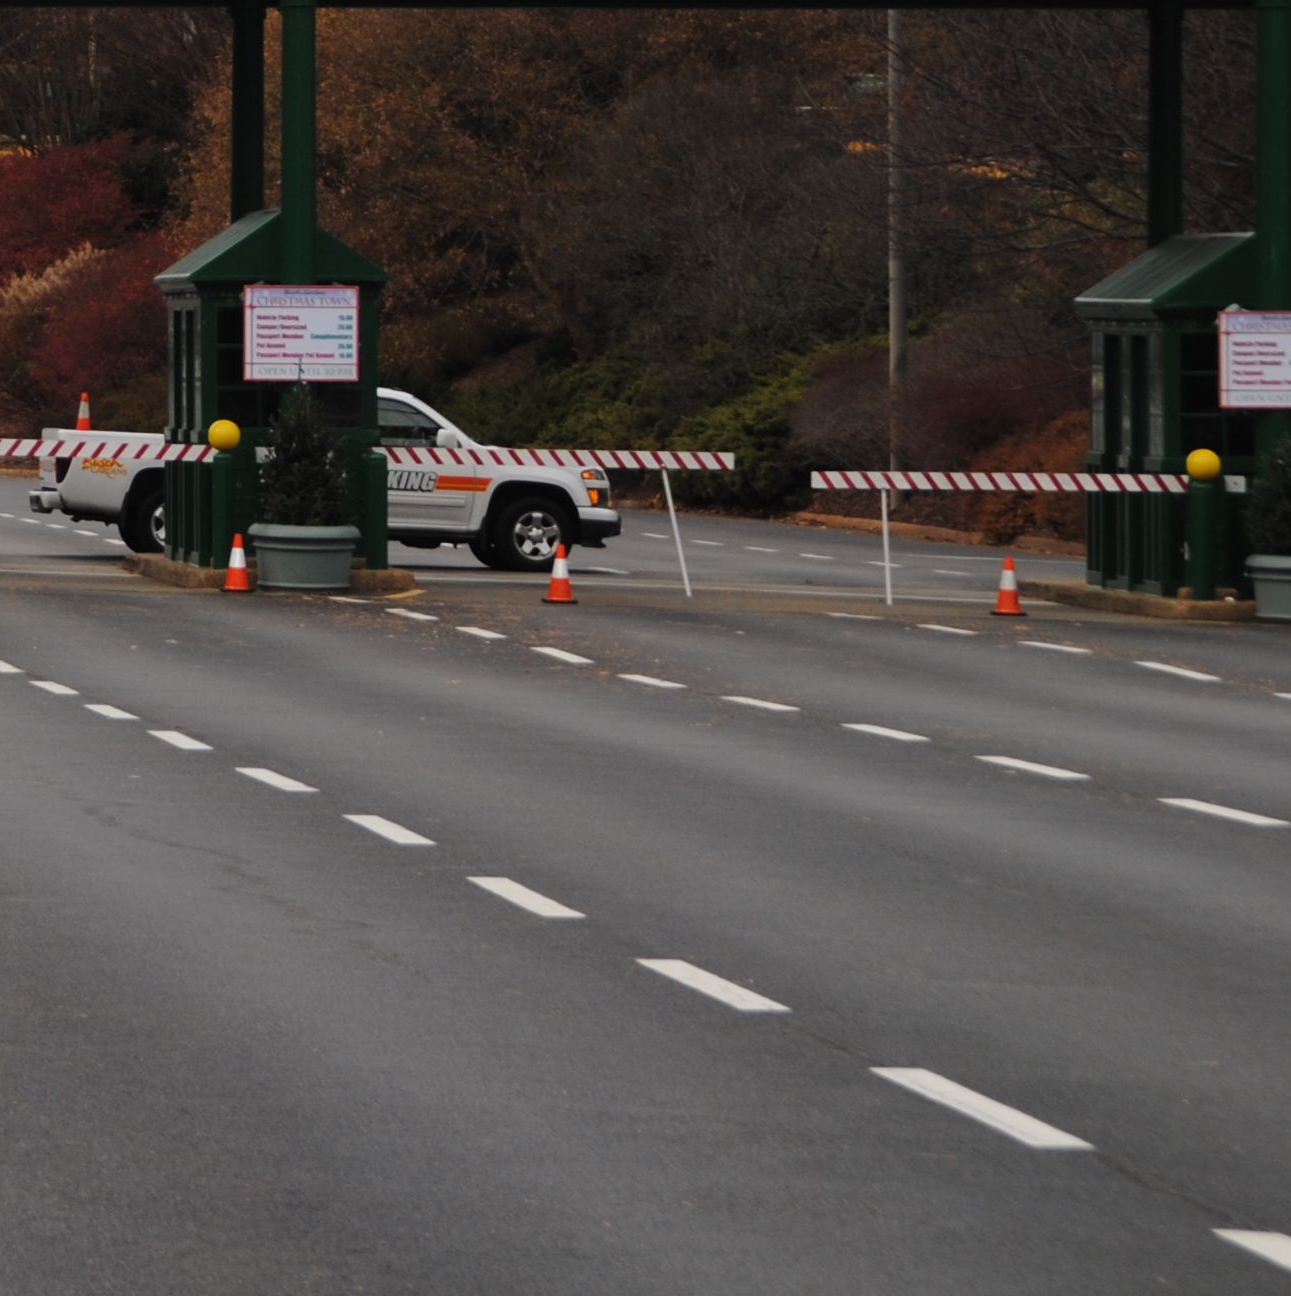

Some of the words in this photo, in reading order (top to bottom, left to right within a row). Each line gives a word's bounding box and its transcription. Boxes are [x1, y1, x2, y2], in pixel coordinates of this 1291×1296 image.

[258, 297, 316, 305] CHRISTMAS
[318, 297, 351, 305] TOWN
[259, 367, 288, 375] OPEN
